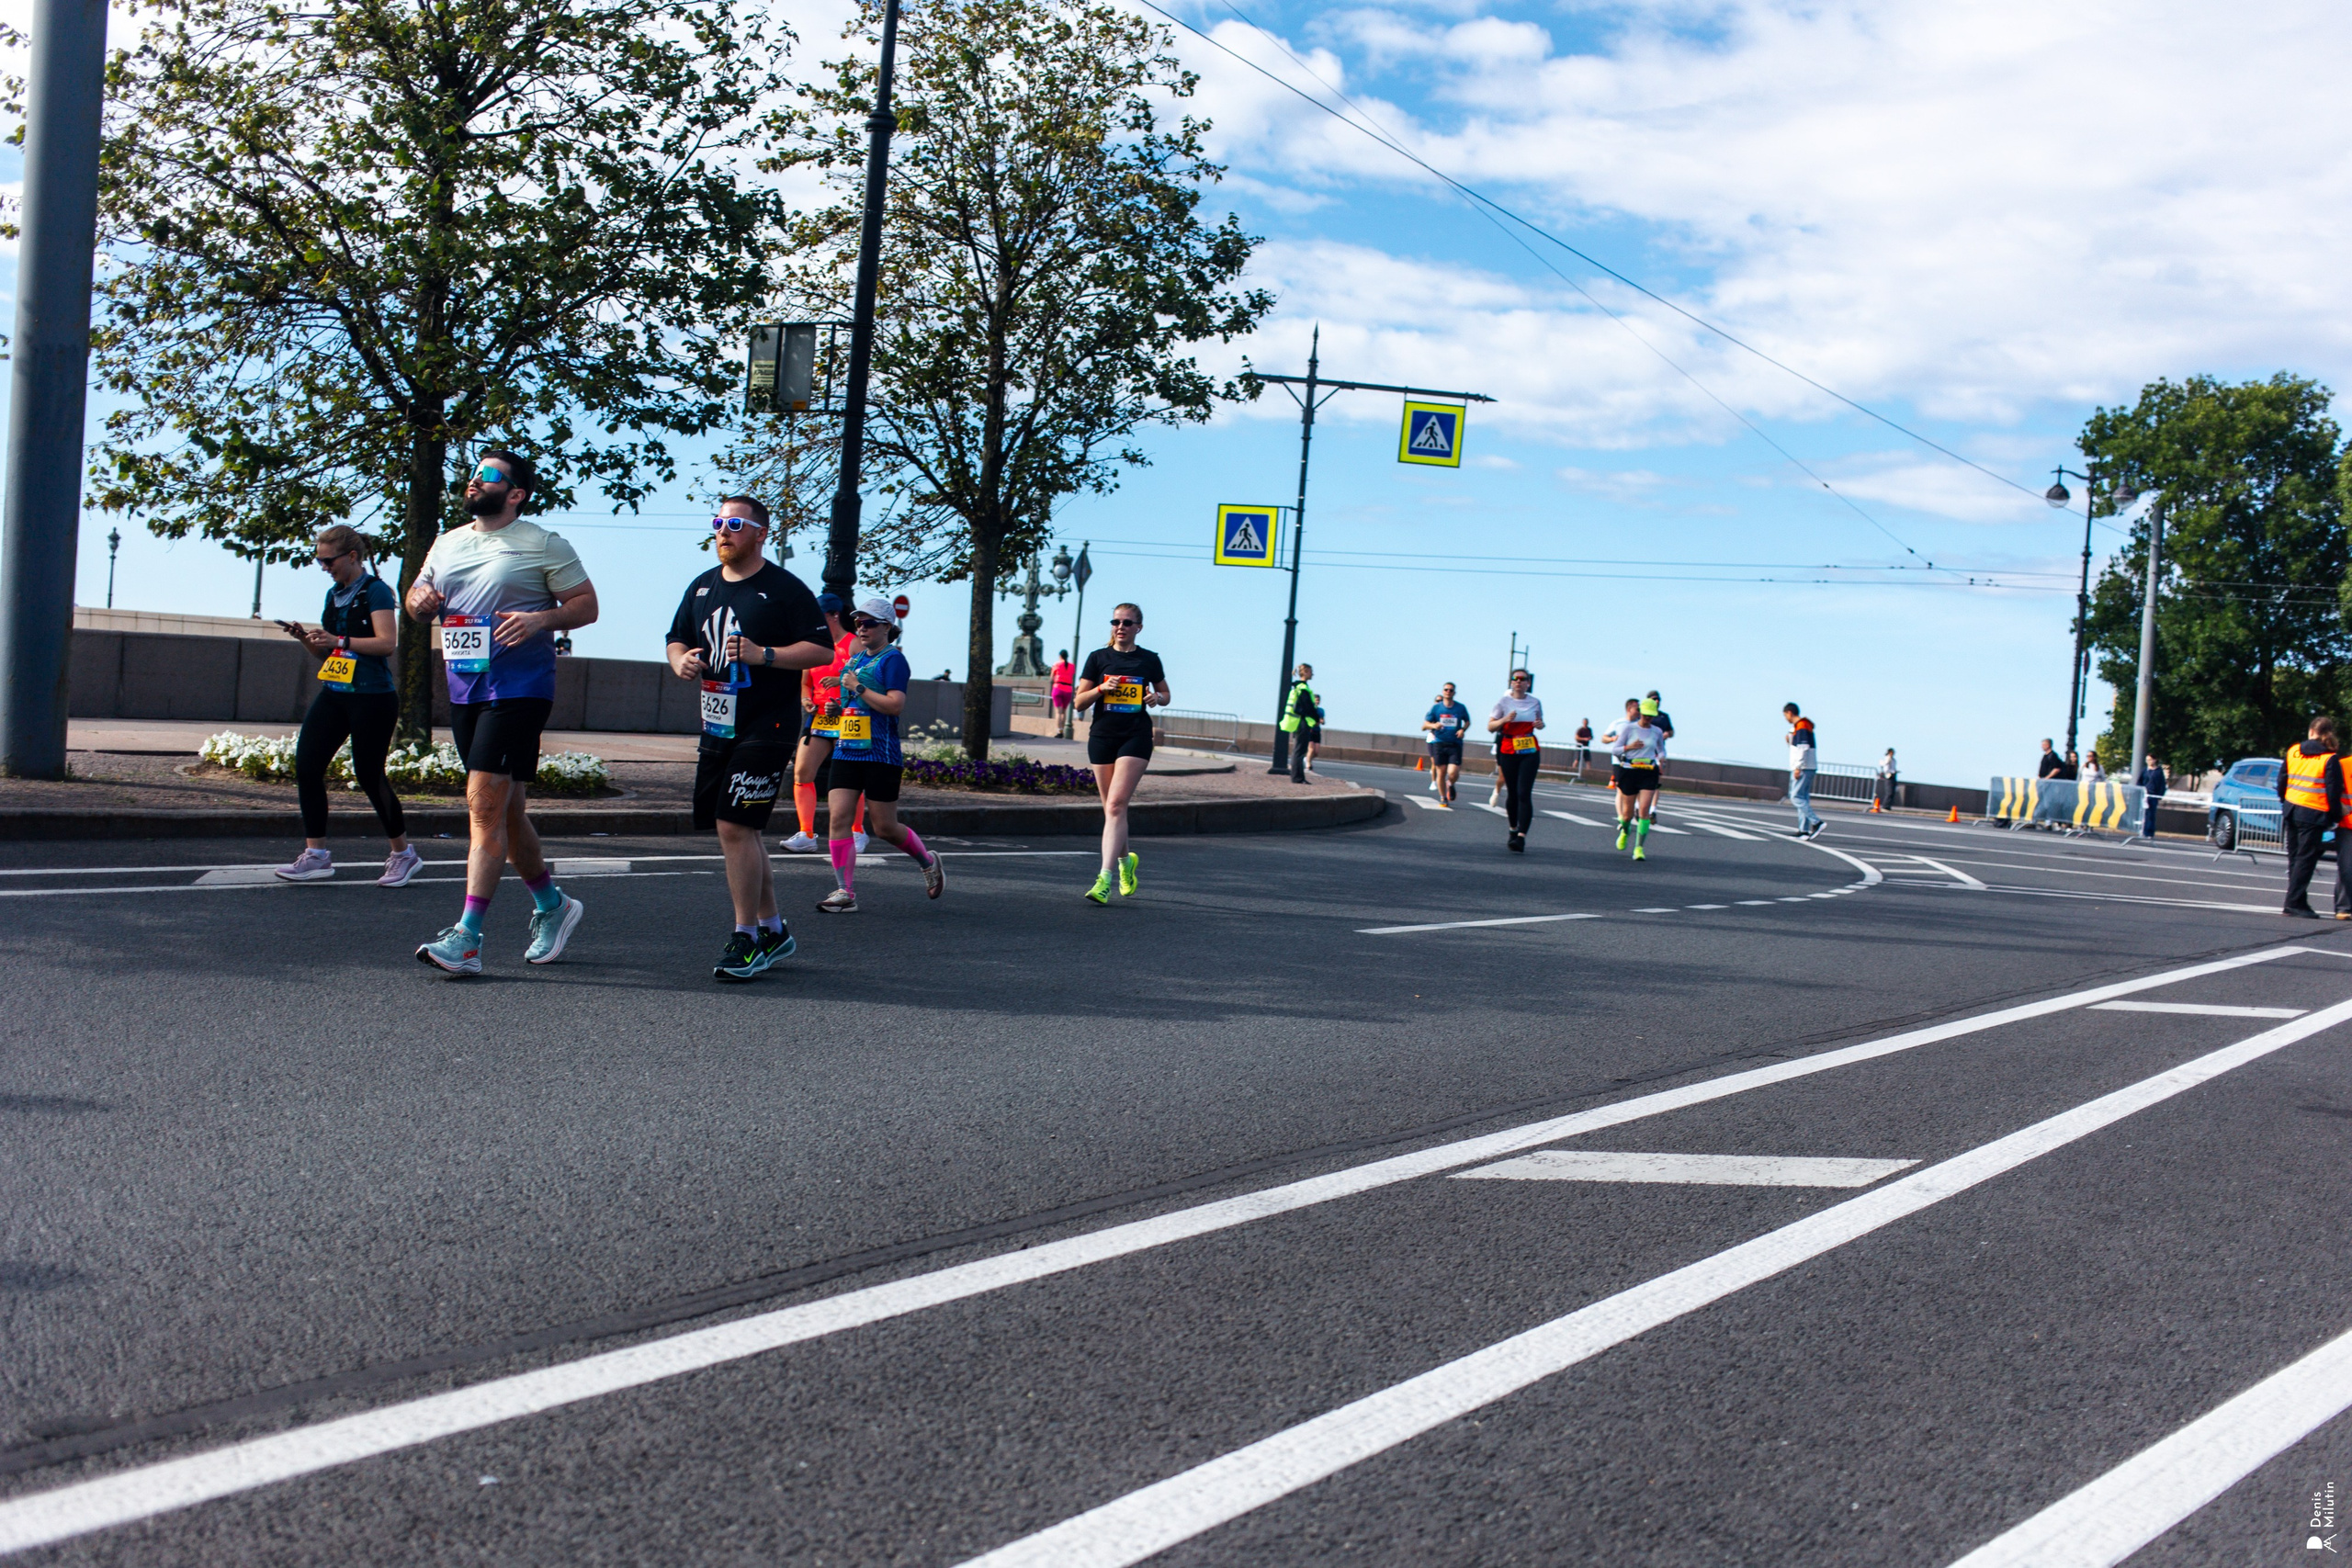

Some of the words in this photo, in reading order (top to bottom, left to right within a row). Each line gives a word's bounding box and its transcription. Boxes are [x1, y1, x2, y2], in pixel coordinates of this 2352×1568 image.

[445, 631, 481, 649] 5625
[1108, 686, 1138, 698] 4548
[702, 694, 729, 716] 5626
[817, 716, 840, 727] 3380
[843, 719, 861, 732] 105
[728, 771, 770, 793] Playa
